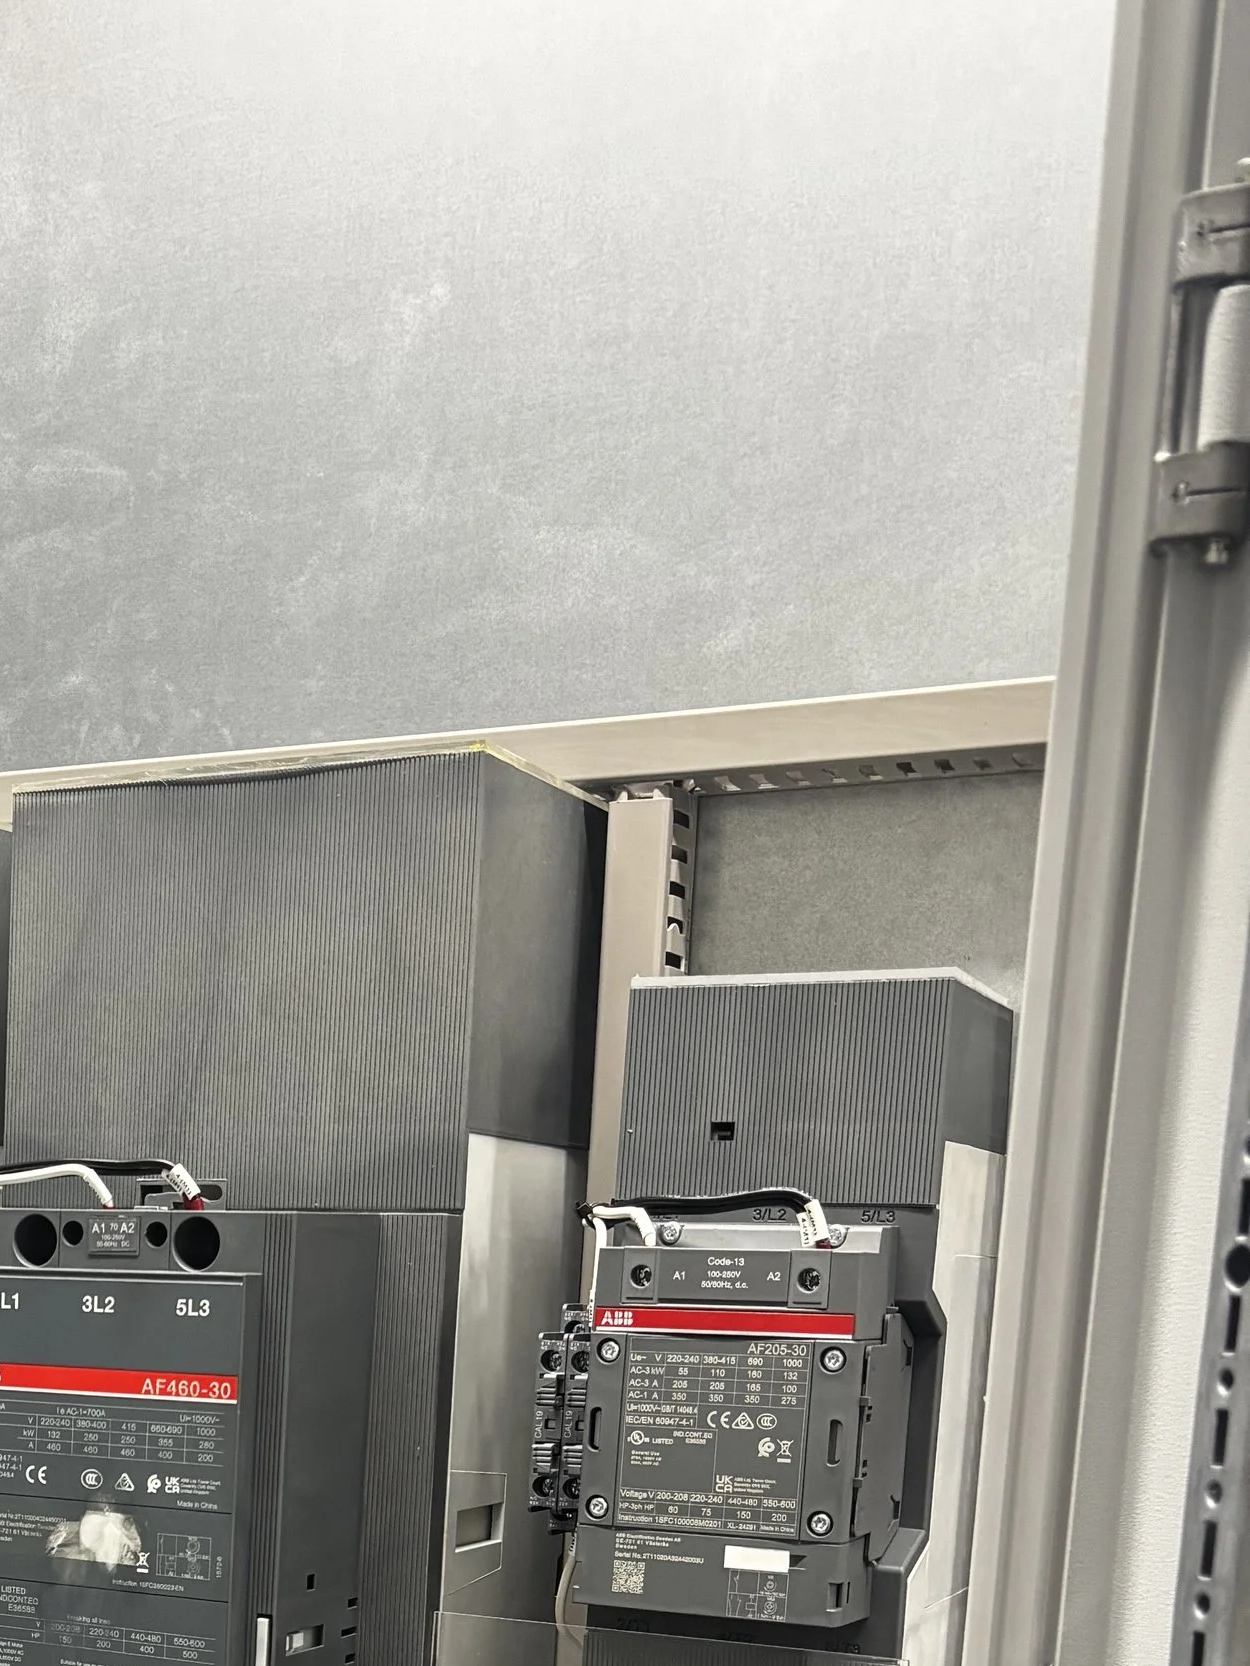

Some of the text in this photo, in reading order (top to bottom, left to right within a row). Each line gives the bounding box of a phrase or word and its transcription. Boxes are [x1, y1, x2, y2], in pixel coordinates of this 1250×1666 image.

[752, 1208, 787, 1222] 3/L2
[860, 1210, 896, 1223] 5/L3
[92, 1222, 105, 1234] A1
[120, 1222, 135, 1234] A2
[707, 1256, 745, 1266] Code-13
[672, 1270, 686, 1280] A1
[707, 1270, 741, 1278] 100-250V
[766, 1271, 781, 1281] A2
[82, 1295, 115, 1314] 3L2
[175, 1298, 210, 1318] 5L3
[601, 1311, 634, 1326] ABB
[747, 1342, 807, 1357] AF205-30
[655, 1353, 803, 1368] V 220-240 380-415 690 1000
[630, 1366, 650, 1375] AC-3
[678, 1367, 689, 1376] 55
[710, 1369, 726, 1377] 110
[783, 1371, 798, 1380] 132
[141, 1378, 231, 1399] AF460-30
[629, 1379, 649, 1387] AC-3
[652, 1379, 659, 1388] A
[672, 1380, 688, 1388] 205
[782, 1385, 797, 1393] 100
[628, 1391, 797, 1405] AC-1 A 350 350 350 275
[40, 1418, 70, 1427] 220-240
[76, 1420, 107, 1429] 380-400
[121, 1423, 136, 1431] 415
[197, 1427, 216, 1436] 1000
[625, 1415, 694, 1426] IEC/EN 60947-4-1
[47, 1431, 61, 1439] 132
[534, 1422, 543, 1438] CAL
[564, 1422, 572, 1438] CAL
[158, 1451, 173, 1459] 400
[197, 1454, 213, 1462] 200
[716, 1475, 734, 1484] UK
[620, 1489, 648, 1500] Voltage
[656, 1492, 688, 1501] 200-208
[690, 1494, 723, 1504] 220-240
[618, 1513, 653, 1522] Instruction
[701, 1508, 712, 1516] 75
[771, 1513, 787, 1522] 200
[1, 1584, 26, 1595] LISTED
[89, 1627, 120, 1638] 220-240
[130, 1632, 162, 1643] 440-480
[96, 1640, 111, 1648] 200
[139, 1646, 155, 1654] 400
